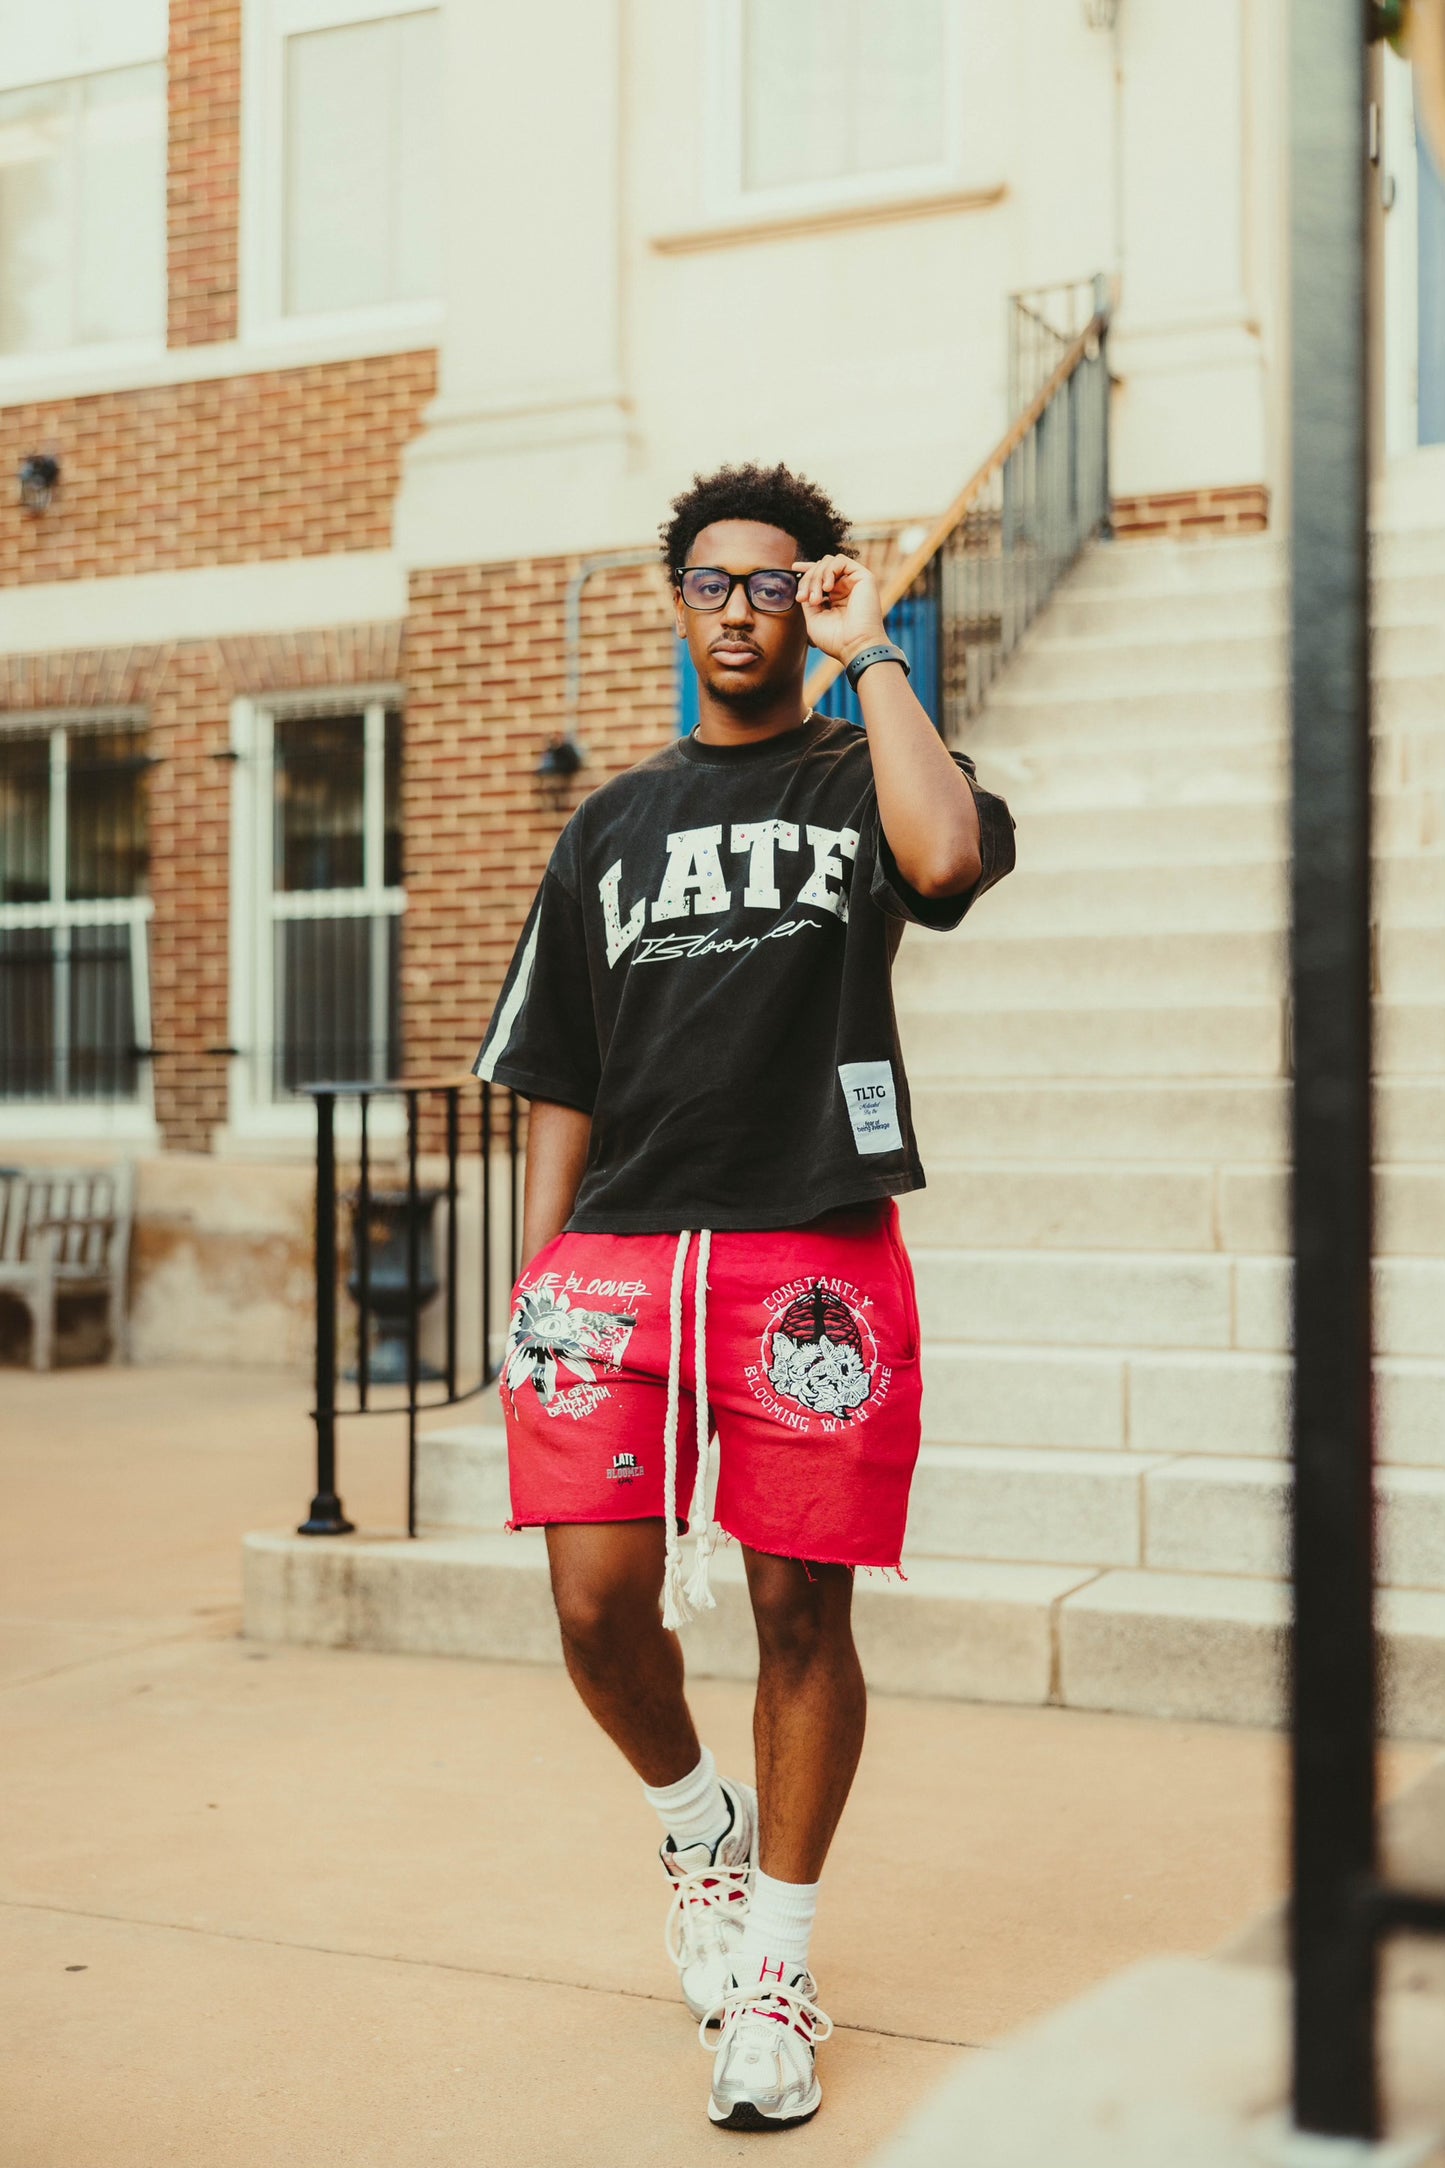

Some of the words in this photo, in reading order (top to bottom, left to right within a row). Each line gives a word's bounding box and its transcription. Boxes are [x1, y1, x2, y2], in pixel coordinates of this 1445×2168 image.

[598, 819, 860, 969] LATE
[853, 1085, 886, 1101] TLTG
[556, 1270, 652, 1310] BLOOMER
[762, 1276, 874, 1312] CONSTANTLY
[546, 1397, 586, 1418] BETTER
[586, 1386, 612, 1409] WITH
[570, 1403, 594, 1421] TIME
[743, 1365, 810, 1433] BLOOMING
[821, 1407, 870, 1433] WITH
[870, 1366, 893, 1407] TIME
[606, 1466, 645, 1479] BLOOMER
[613, 1453, 635, 1468] LATE
